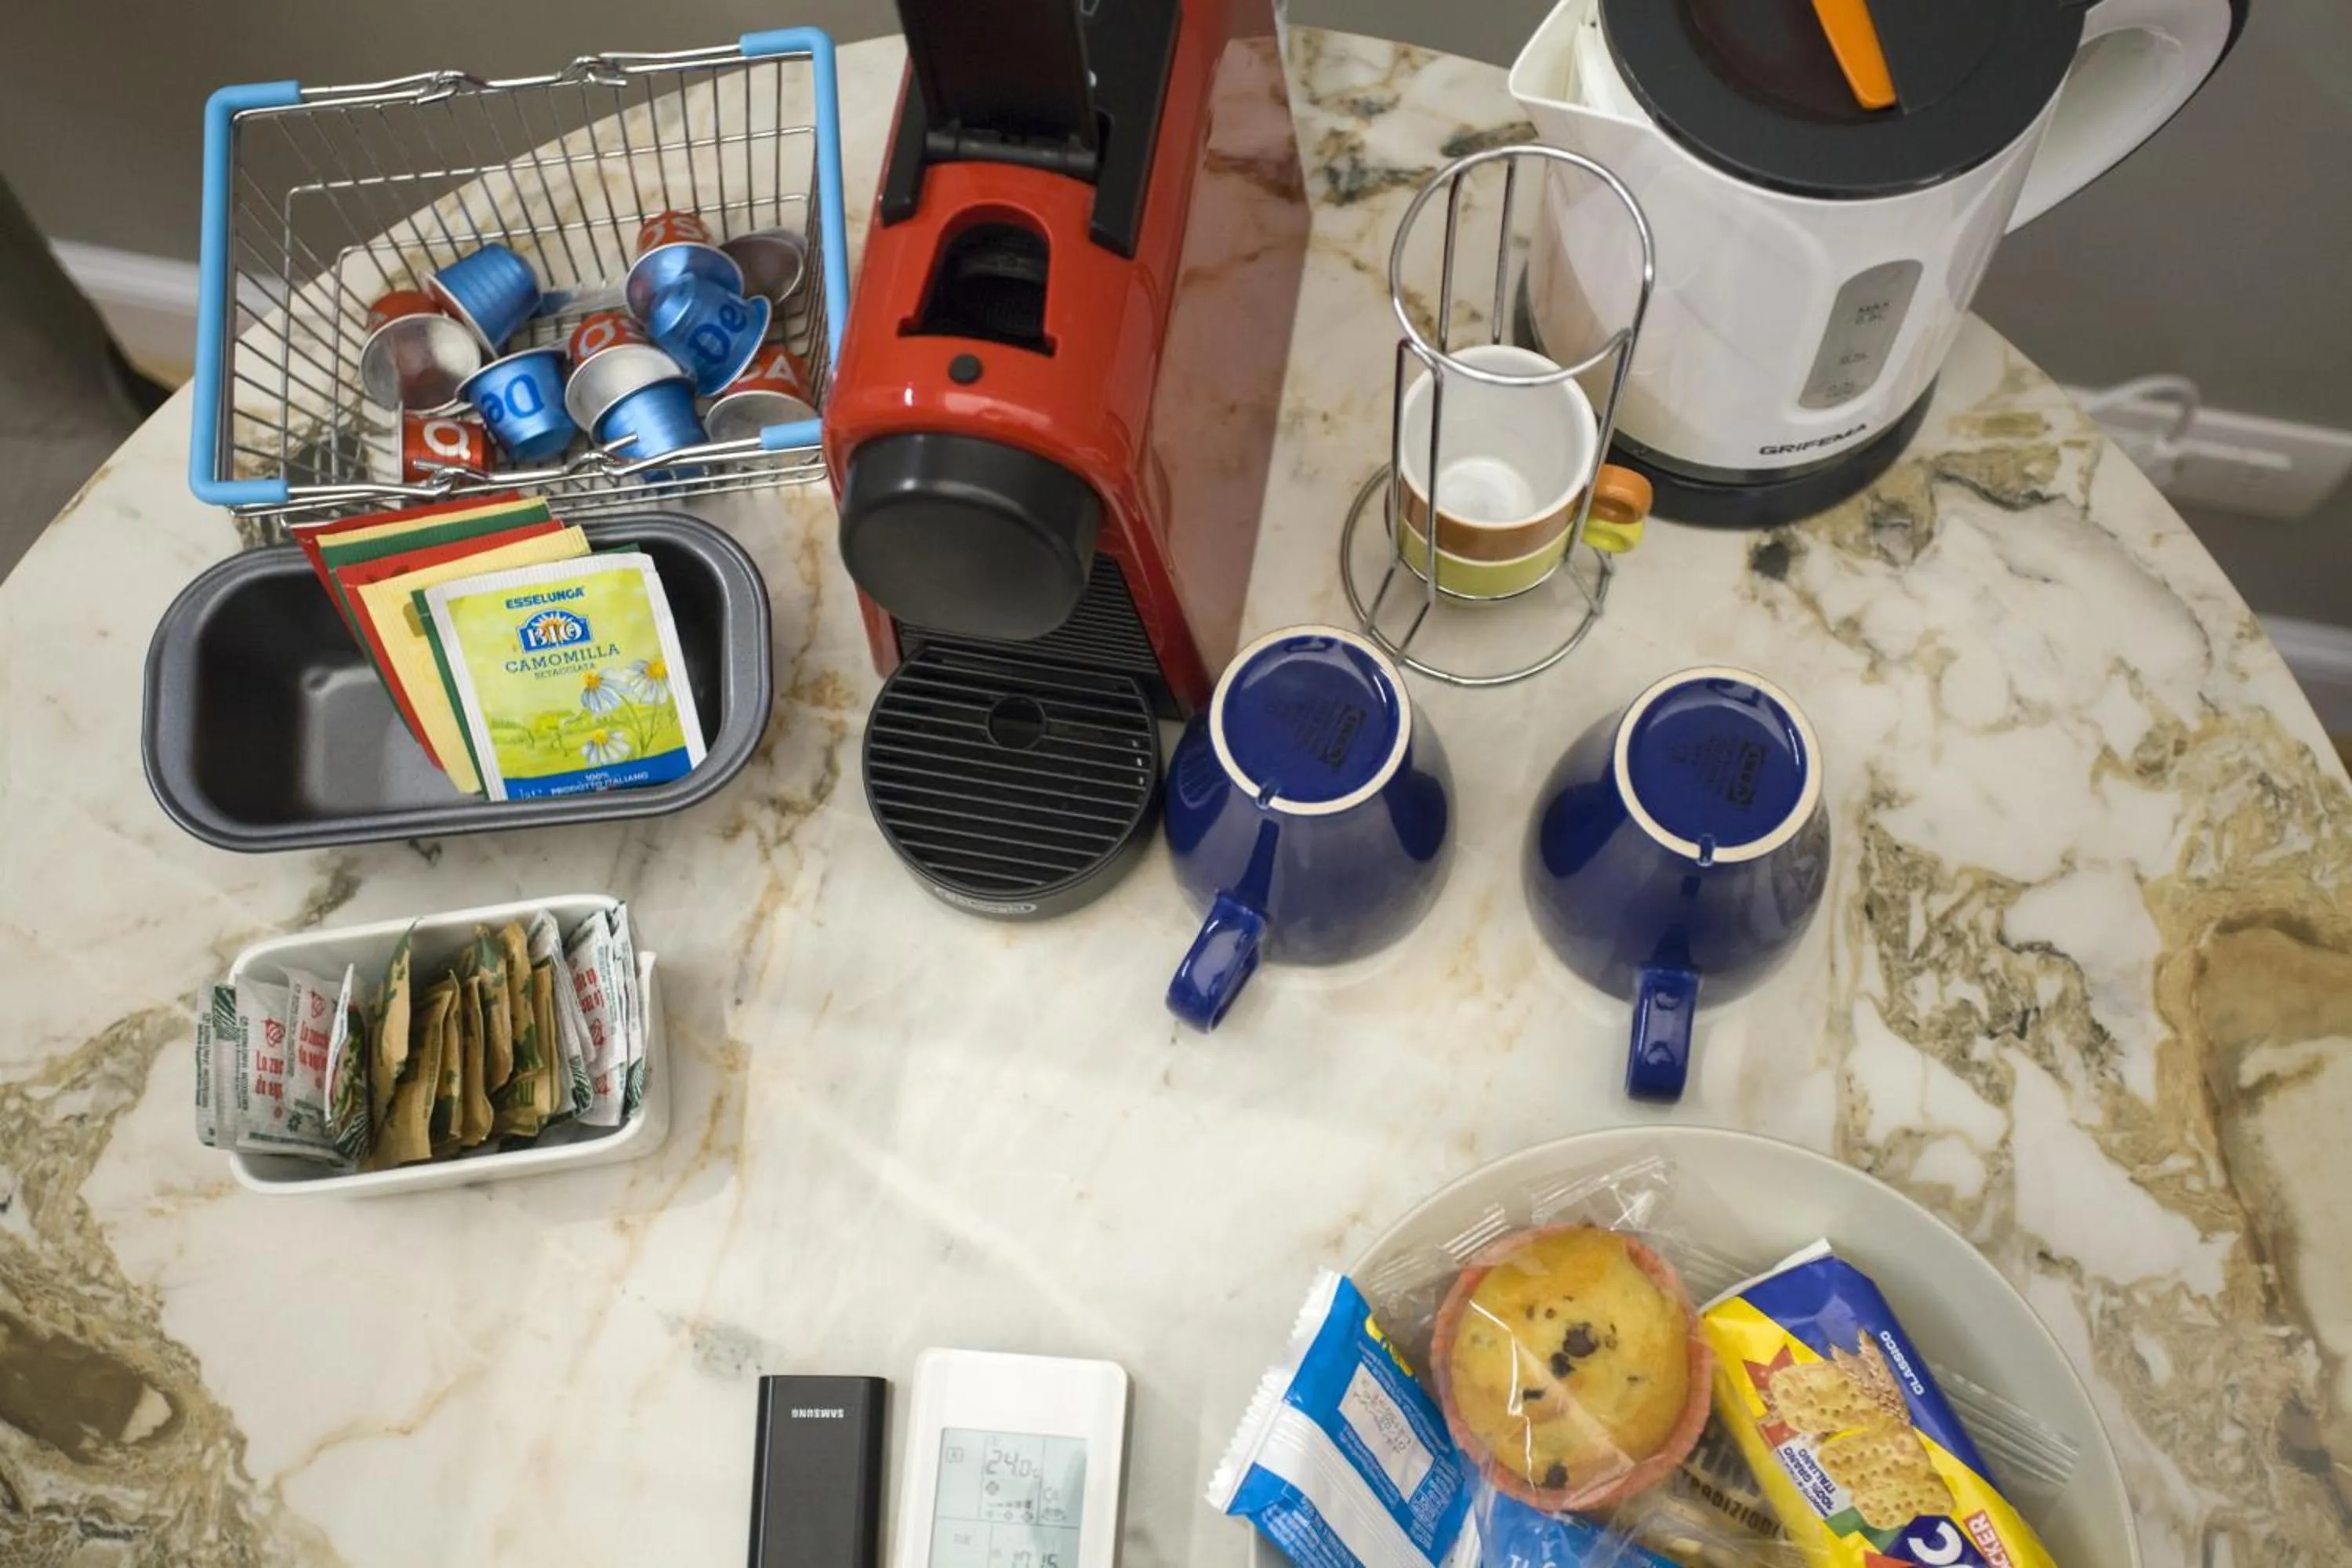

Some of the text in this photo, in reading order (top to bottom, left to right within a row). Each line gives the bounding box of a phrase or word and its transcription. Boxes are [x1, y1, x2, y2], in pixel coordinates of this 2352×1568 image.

[1759, 423, 1868, 456] GRIFEMA
[505, 586, 586, 609] ESSELUNGA
[526, 621, 583, 648] BIO
[504, 643, 621, 673] CAMOMILLA
[1879, 1329, 1926, 1396] CLASSICO
[790, 1408, 844, 1418] SAMSUNG
[1783, 1446, 1813, 1483] GRANO
[1798, 1448, 1836, 1494] ITALIANO
